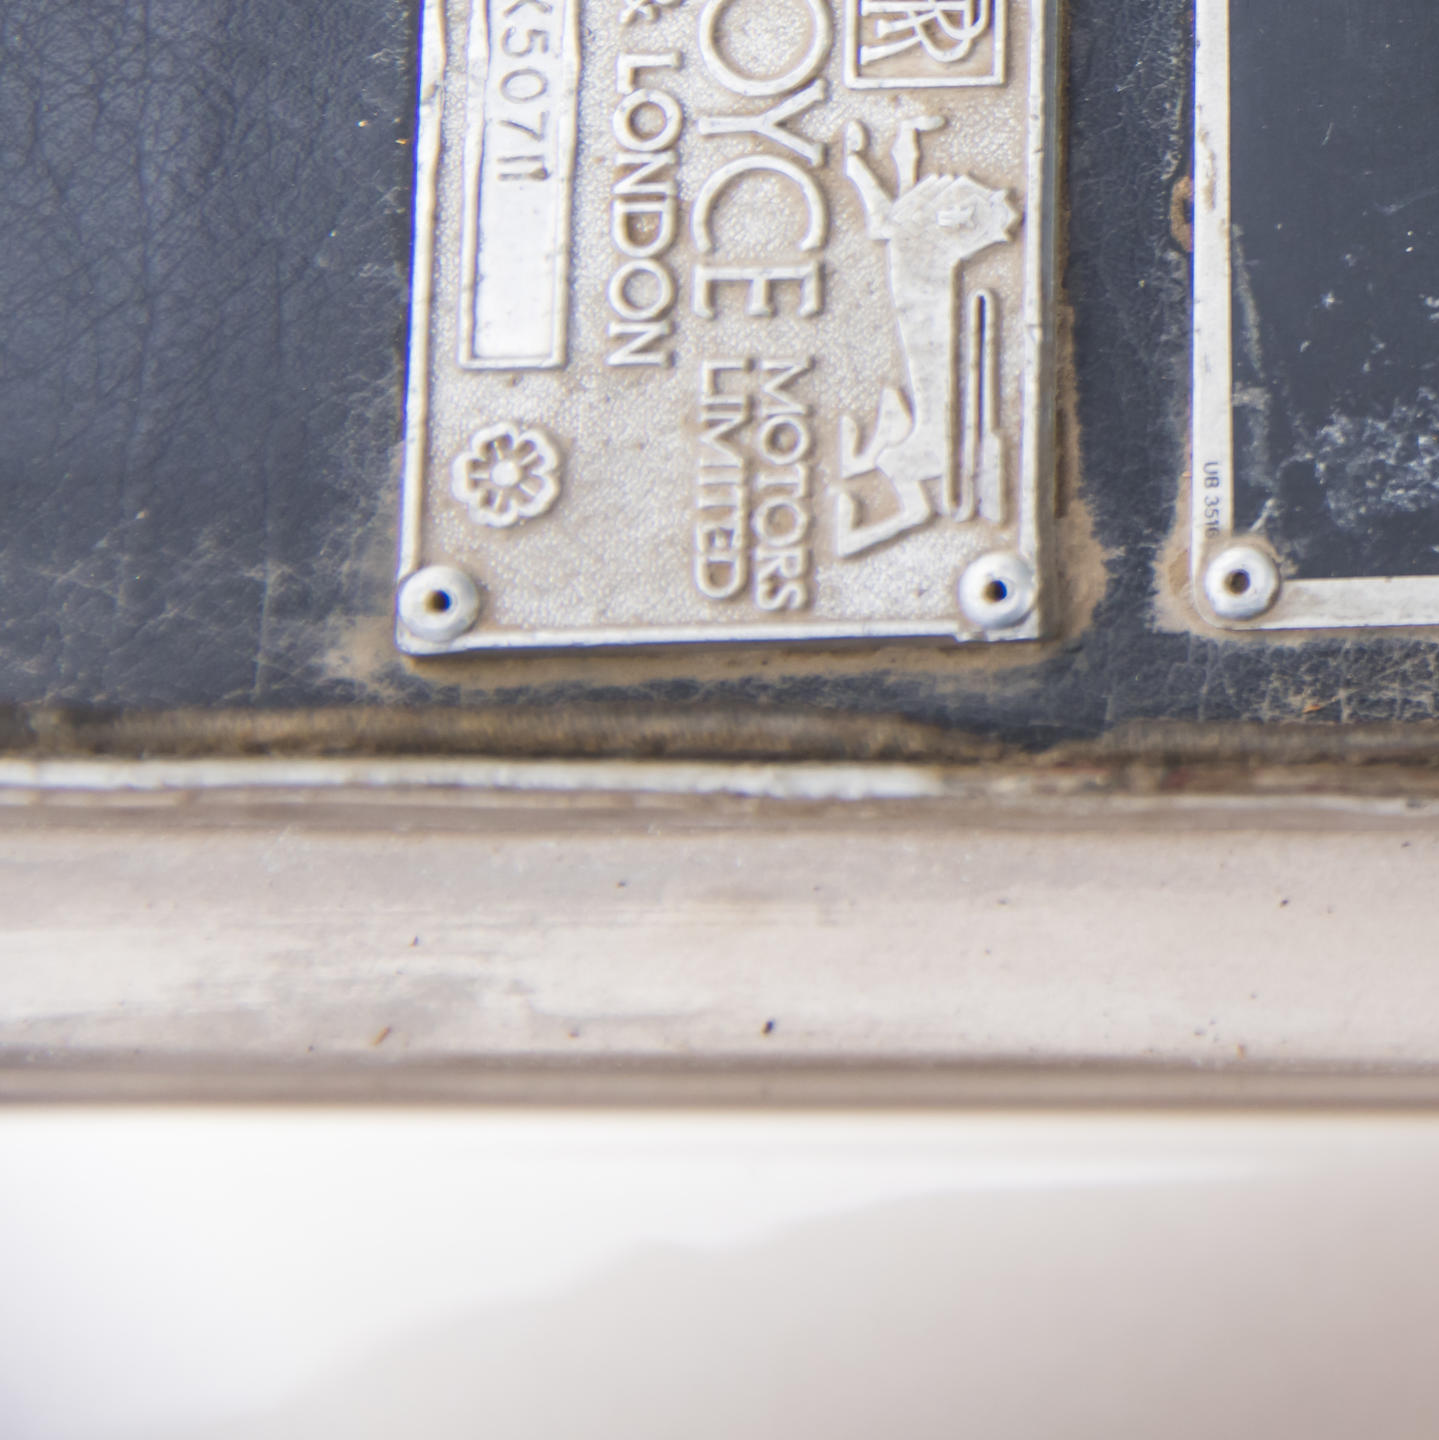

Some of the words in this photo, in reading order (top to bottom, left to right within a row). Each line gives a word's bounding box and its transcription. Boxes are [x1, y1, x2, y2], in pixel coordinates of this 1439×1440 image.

[608, 51, 683, 367] LONDON
[696, 360, 751, 599] LIMITED
[753, 359, 814, 611] MOTORS
[1203, 461, 1220, 488] UB
